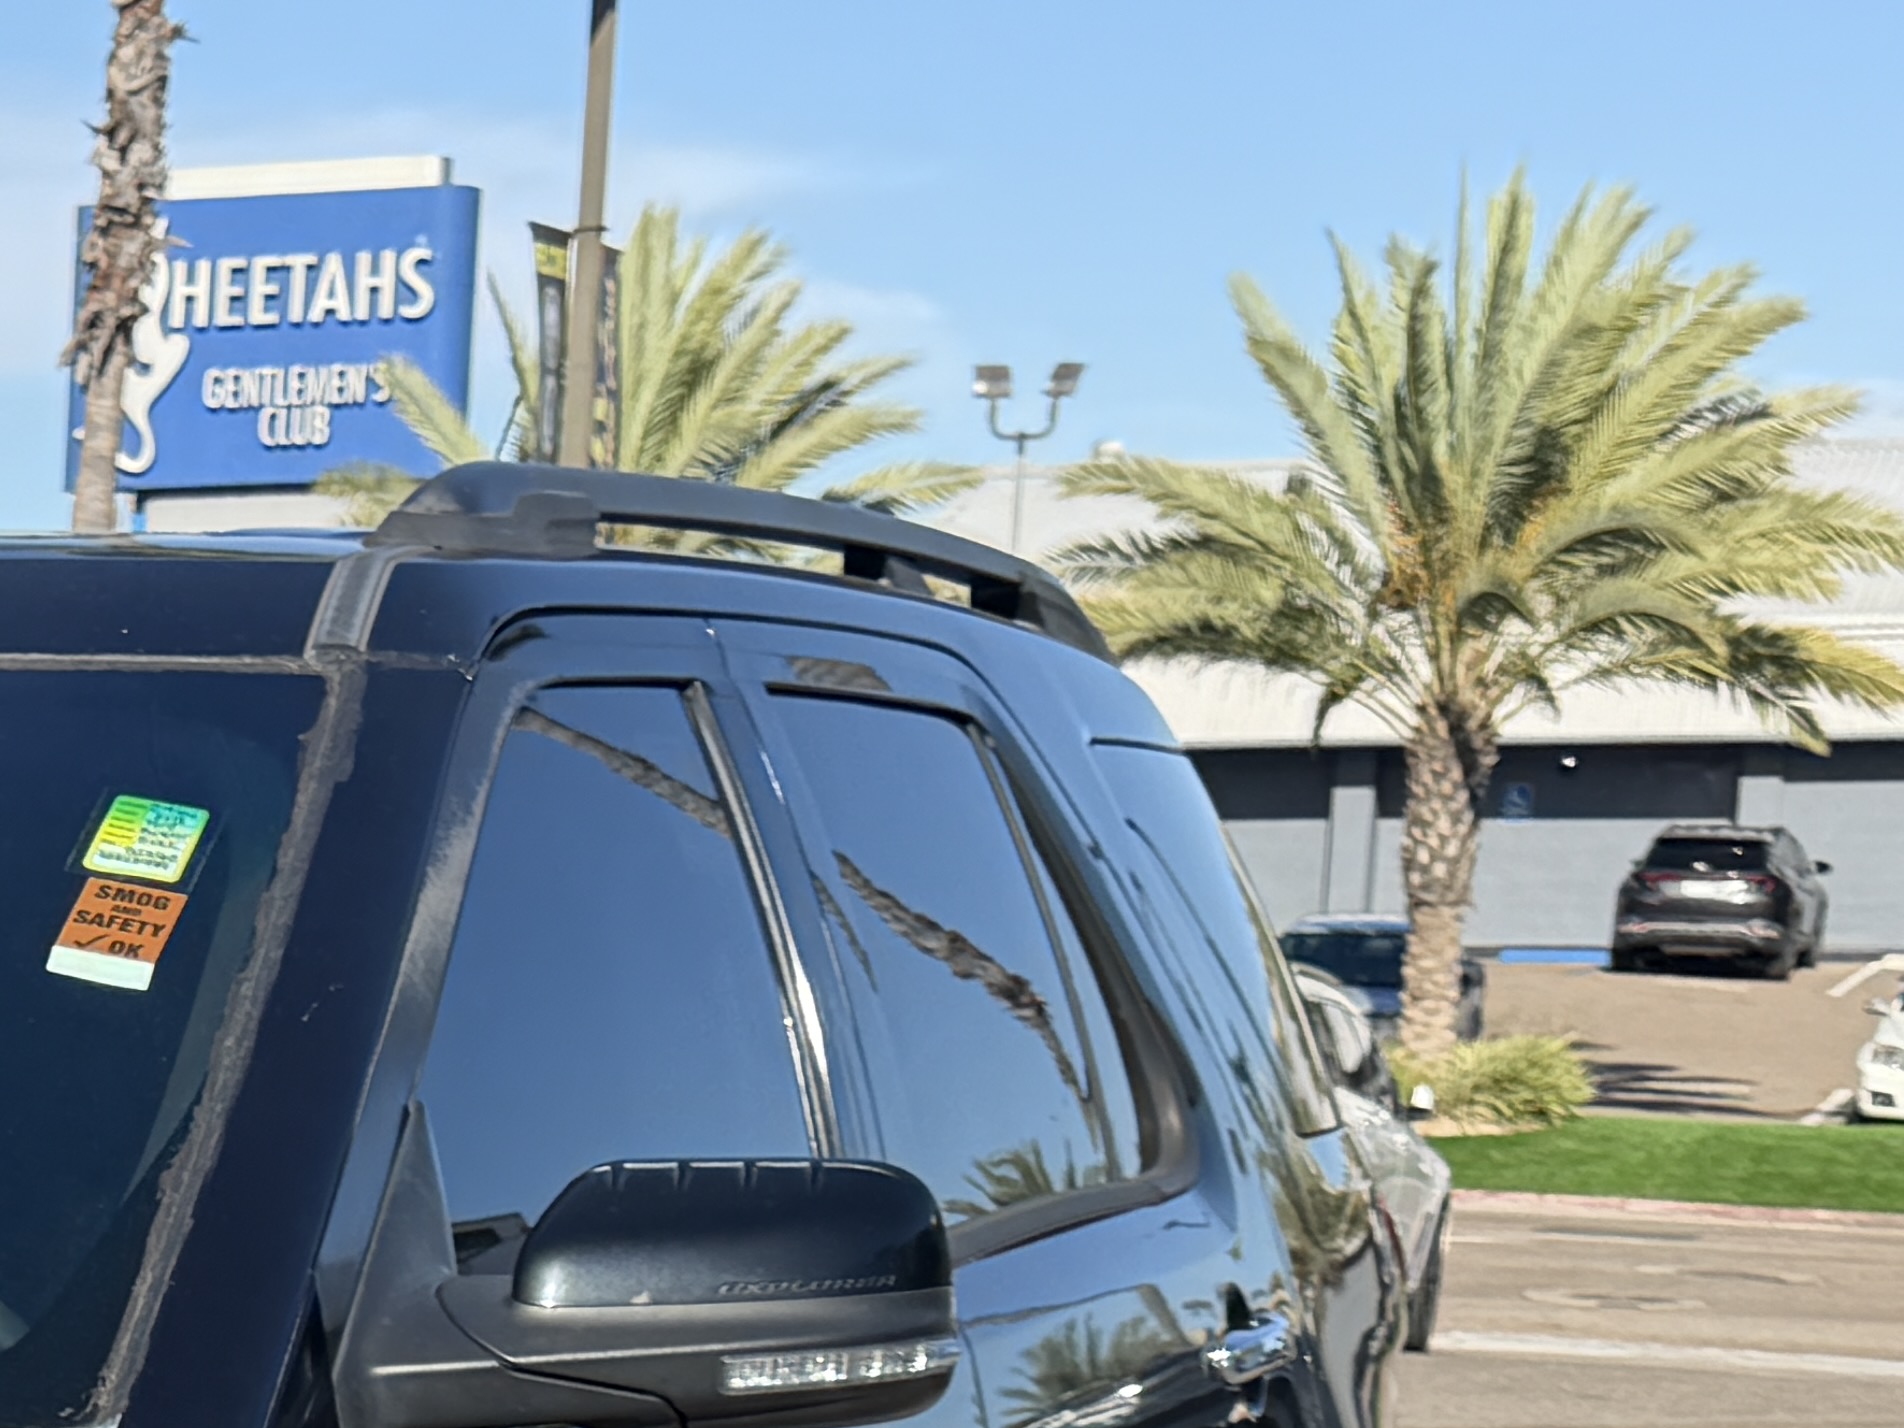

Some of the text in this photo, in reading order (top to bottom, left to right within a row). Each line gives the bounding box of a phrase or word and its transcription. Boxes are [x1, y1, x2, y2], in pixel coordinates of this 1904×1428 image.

[202, 362, 392, 411] GENTLEMEN'S
[257, 406, 333, 447] CLUB
[94, 884, 171, 911] SMOG
[73, 909, 167, 938] SAFETY
[107, 940, 146, 959] OK
